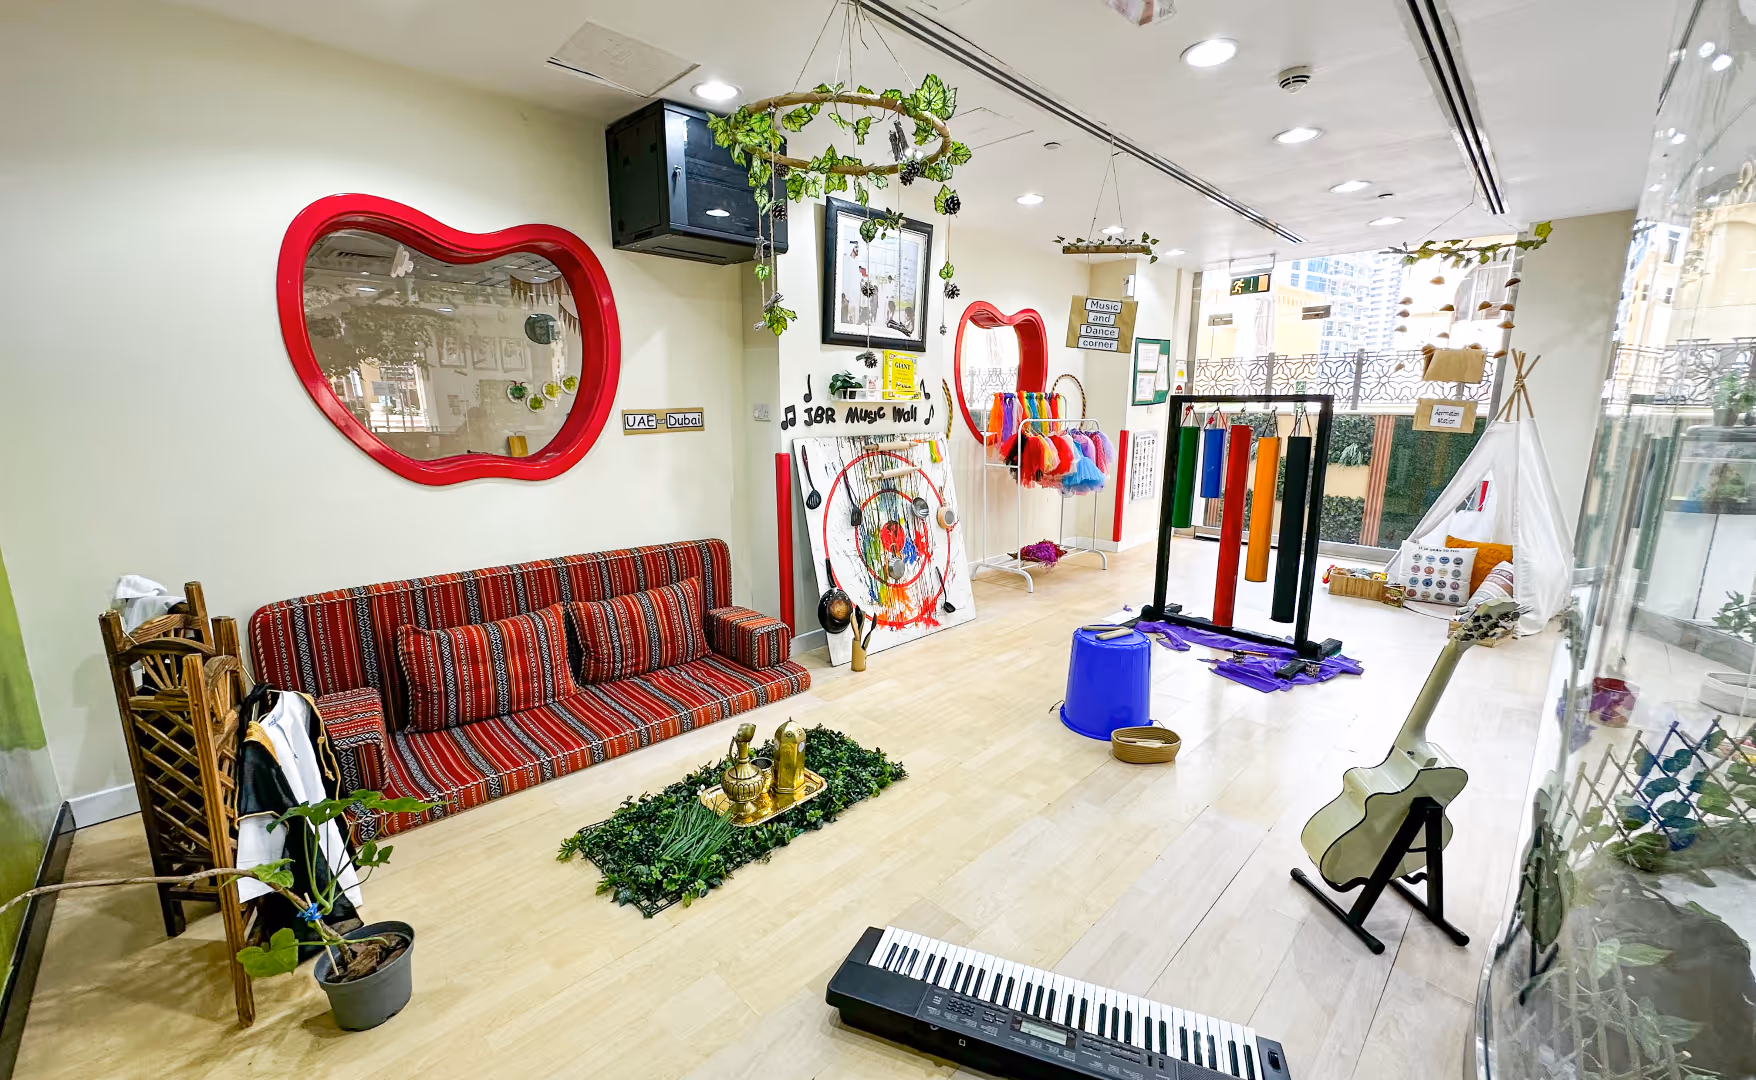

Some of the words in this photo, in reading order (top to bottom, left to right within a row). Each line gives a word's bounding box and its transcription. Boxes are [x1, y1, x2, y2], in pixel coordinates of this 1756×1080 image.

[1090, 300, 1119, 311] Music
[1092, 313, 1111, 323] and
[1085, 325, 1115, 336] Dance
[1082, 339, 1114, 348] corner
[894, 361, 911, 370] GIANT
[626, 415, 655, 428] UAE
[668, 413, 701, 427] Dubai
[803, 405, 836, 426] JBR
[892, 404, 917, 423] Wall
